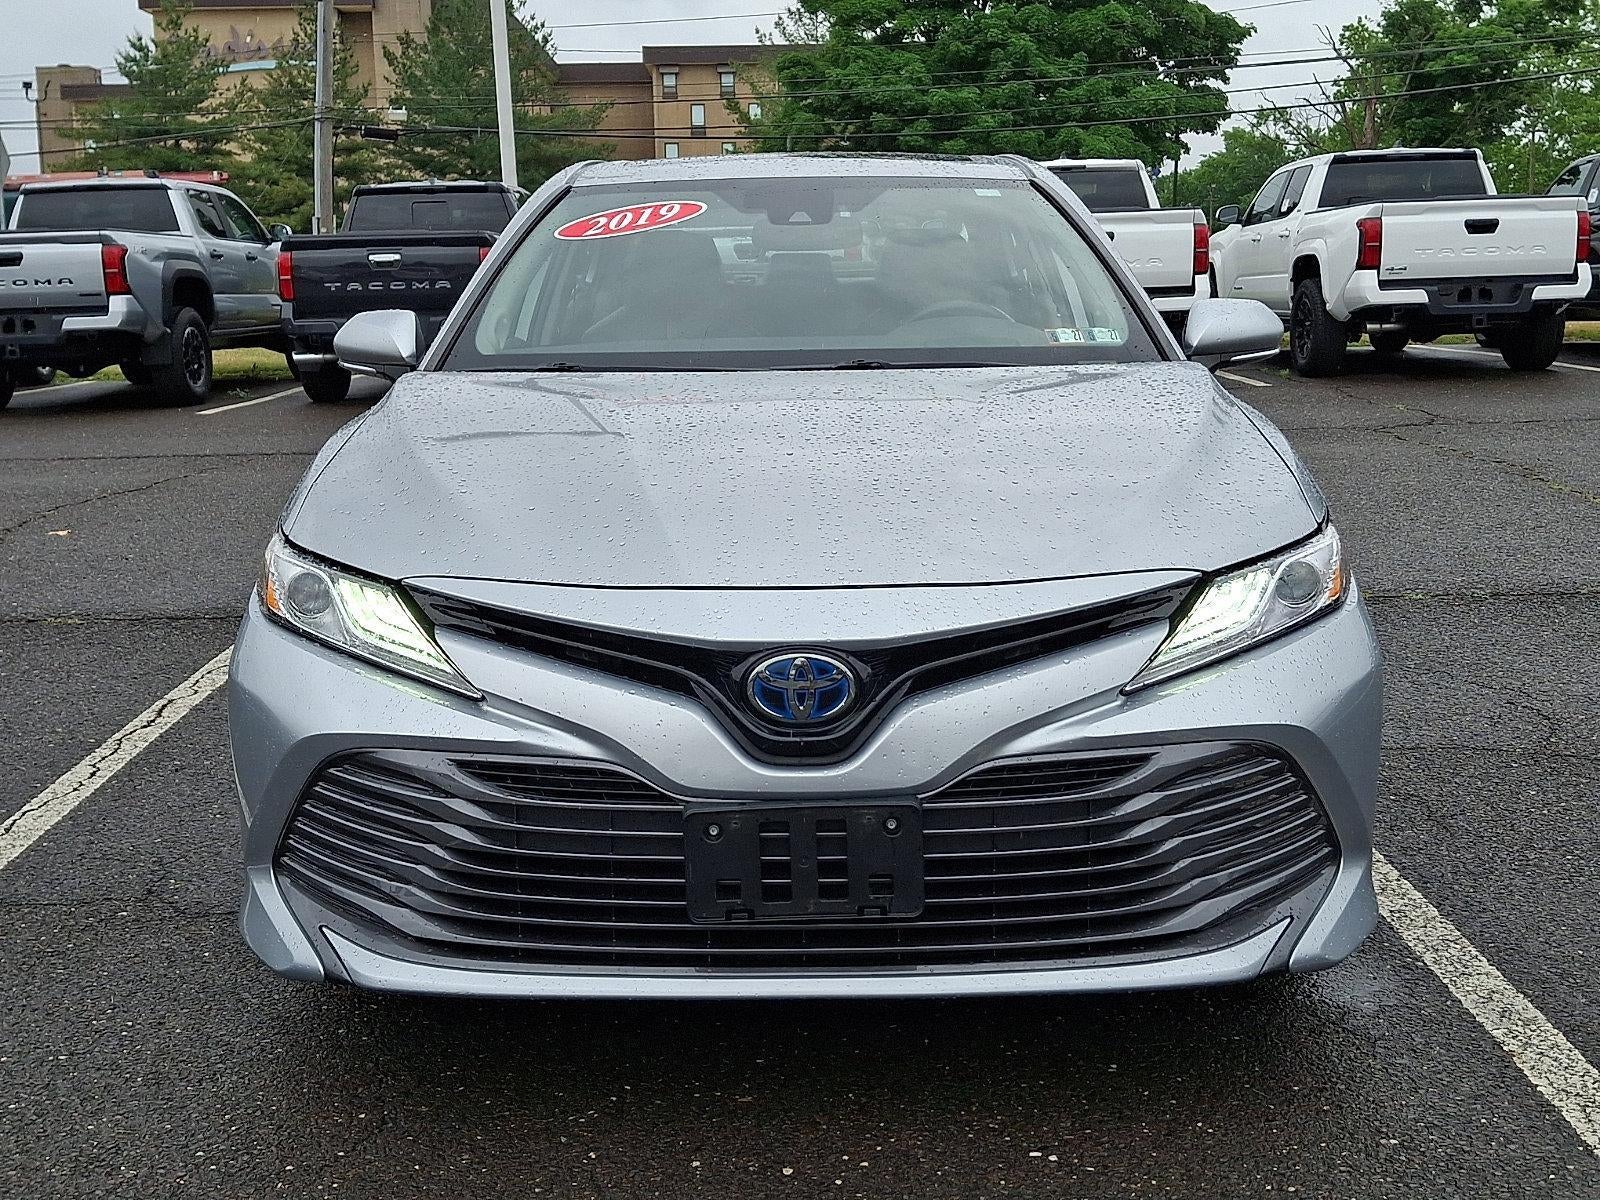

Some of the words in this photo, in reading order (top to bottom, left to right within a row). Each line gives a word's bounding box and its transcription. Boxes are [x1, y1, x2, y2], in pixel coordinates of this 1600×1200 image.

[581, 203, 681, 237] 2019
[1413, 244, 1547, 258] TACOMA
[323, 280, 452, 291] TACOMA
[1071, 329, 1082, 342] 27
[1107, 329, 1119, 341] 27
